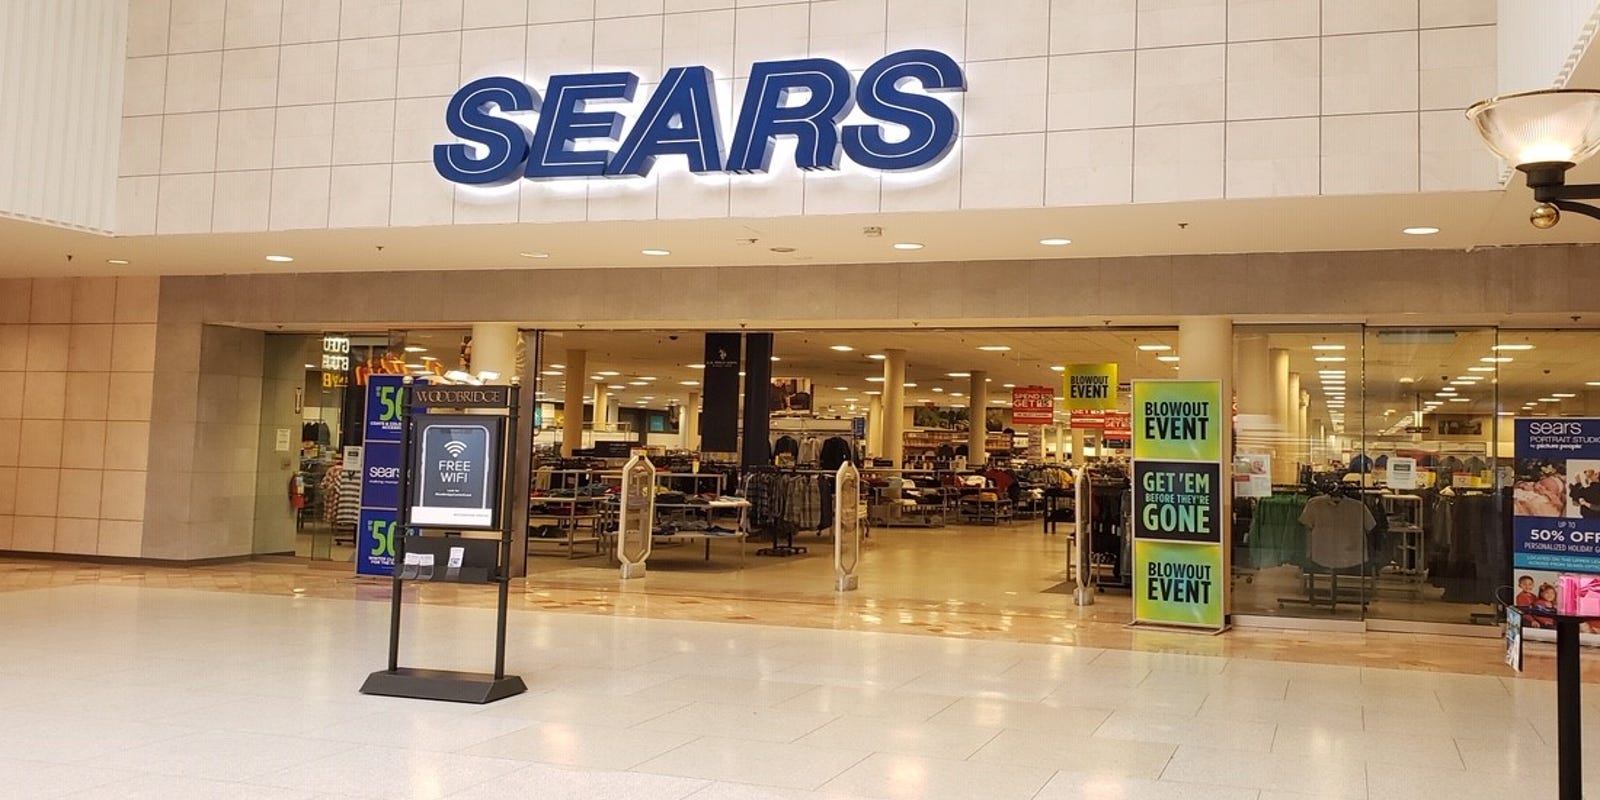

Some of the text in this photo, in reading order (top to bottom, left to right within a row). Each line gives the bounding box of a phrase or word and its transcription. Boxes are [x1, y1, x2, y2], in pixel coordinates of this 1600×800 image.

[433, 48, 966, 186] SEARS
[1070, 375, 1109, 385] BLOWOUT
[416, 391, 501, 402] WOODBRIDGE
[1070, 384, 1109, 399] EVENT
[1013, 399, 1035, 408] GET
[1145, 401, 1209, 417] BLOWOUT
[1145, 417, 1209, 440] EVENT
[1530, 422, 1582, 435] sears
[438, 460, 471, 471] FREE
[440, 472, 468, 483] WIFI
[1142, 471, 1176, 493] GET
[1178, 472, 1210, 494] 'EM
[1145, 492, 1210, 505] BEFORE THEY'RE
[1142, 503, 1211, 534] GONE
[1557, 521, 1567, 529] UP
[1530, 529, 1565, 542] 50%
[1524, 542, 1567, 551] PERSONALIZED
[1568, 544, 1594, 553] HOLIDAY
[1148, 562, 1211, 580] BLOWOUT
[1147, 577, 1212, 604] EVENT
